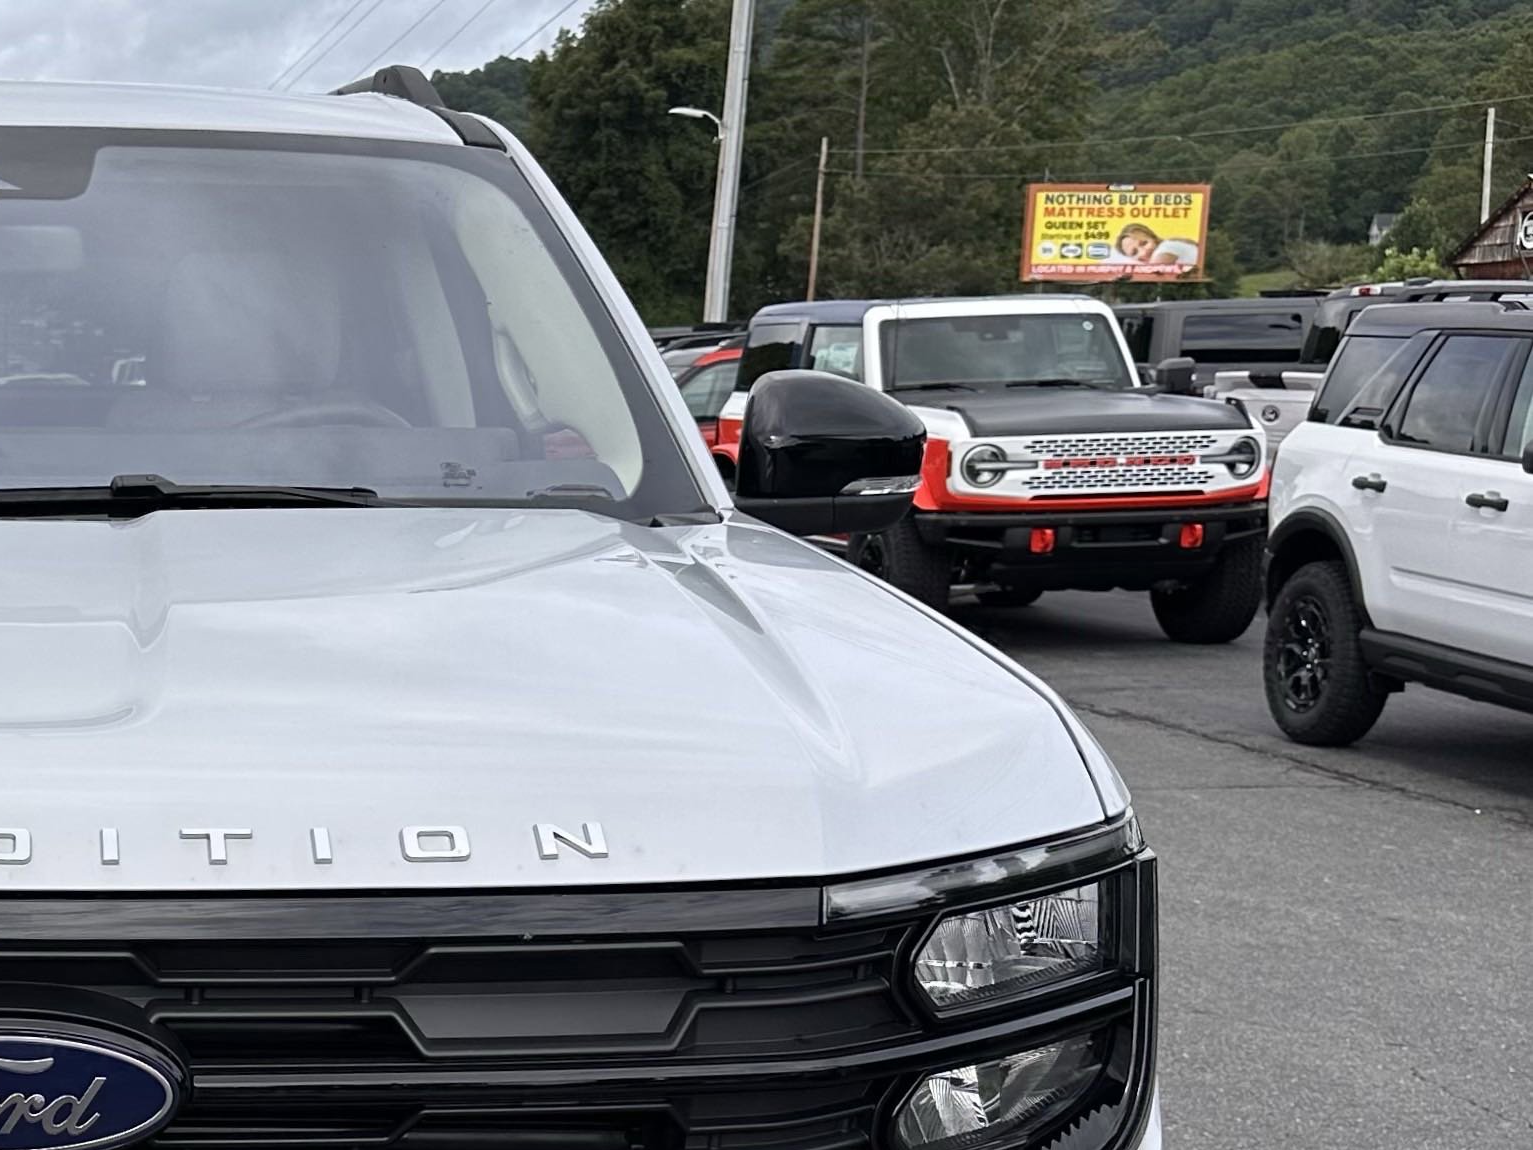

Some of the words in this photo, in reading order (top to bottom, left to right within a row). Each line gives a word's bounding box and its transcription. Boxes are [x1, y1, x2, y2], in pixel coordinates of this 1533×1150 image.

[1044, 193, 1113, 206] NOTHING
[1118, 194, 1148, 206] BUT
[1153, 194, 1193, 206] BEDS
[1043, 206, 1126, 218] MATTRESS
[1130, 207, 1191, 218] OUTLET
[1044, 220, 1084, 230] QUEEN
[1086, 221, 1107, 230] SET
